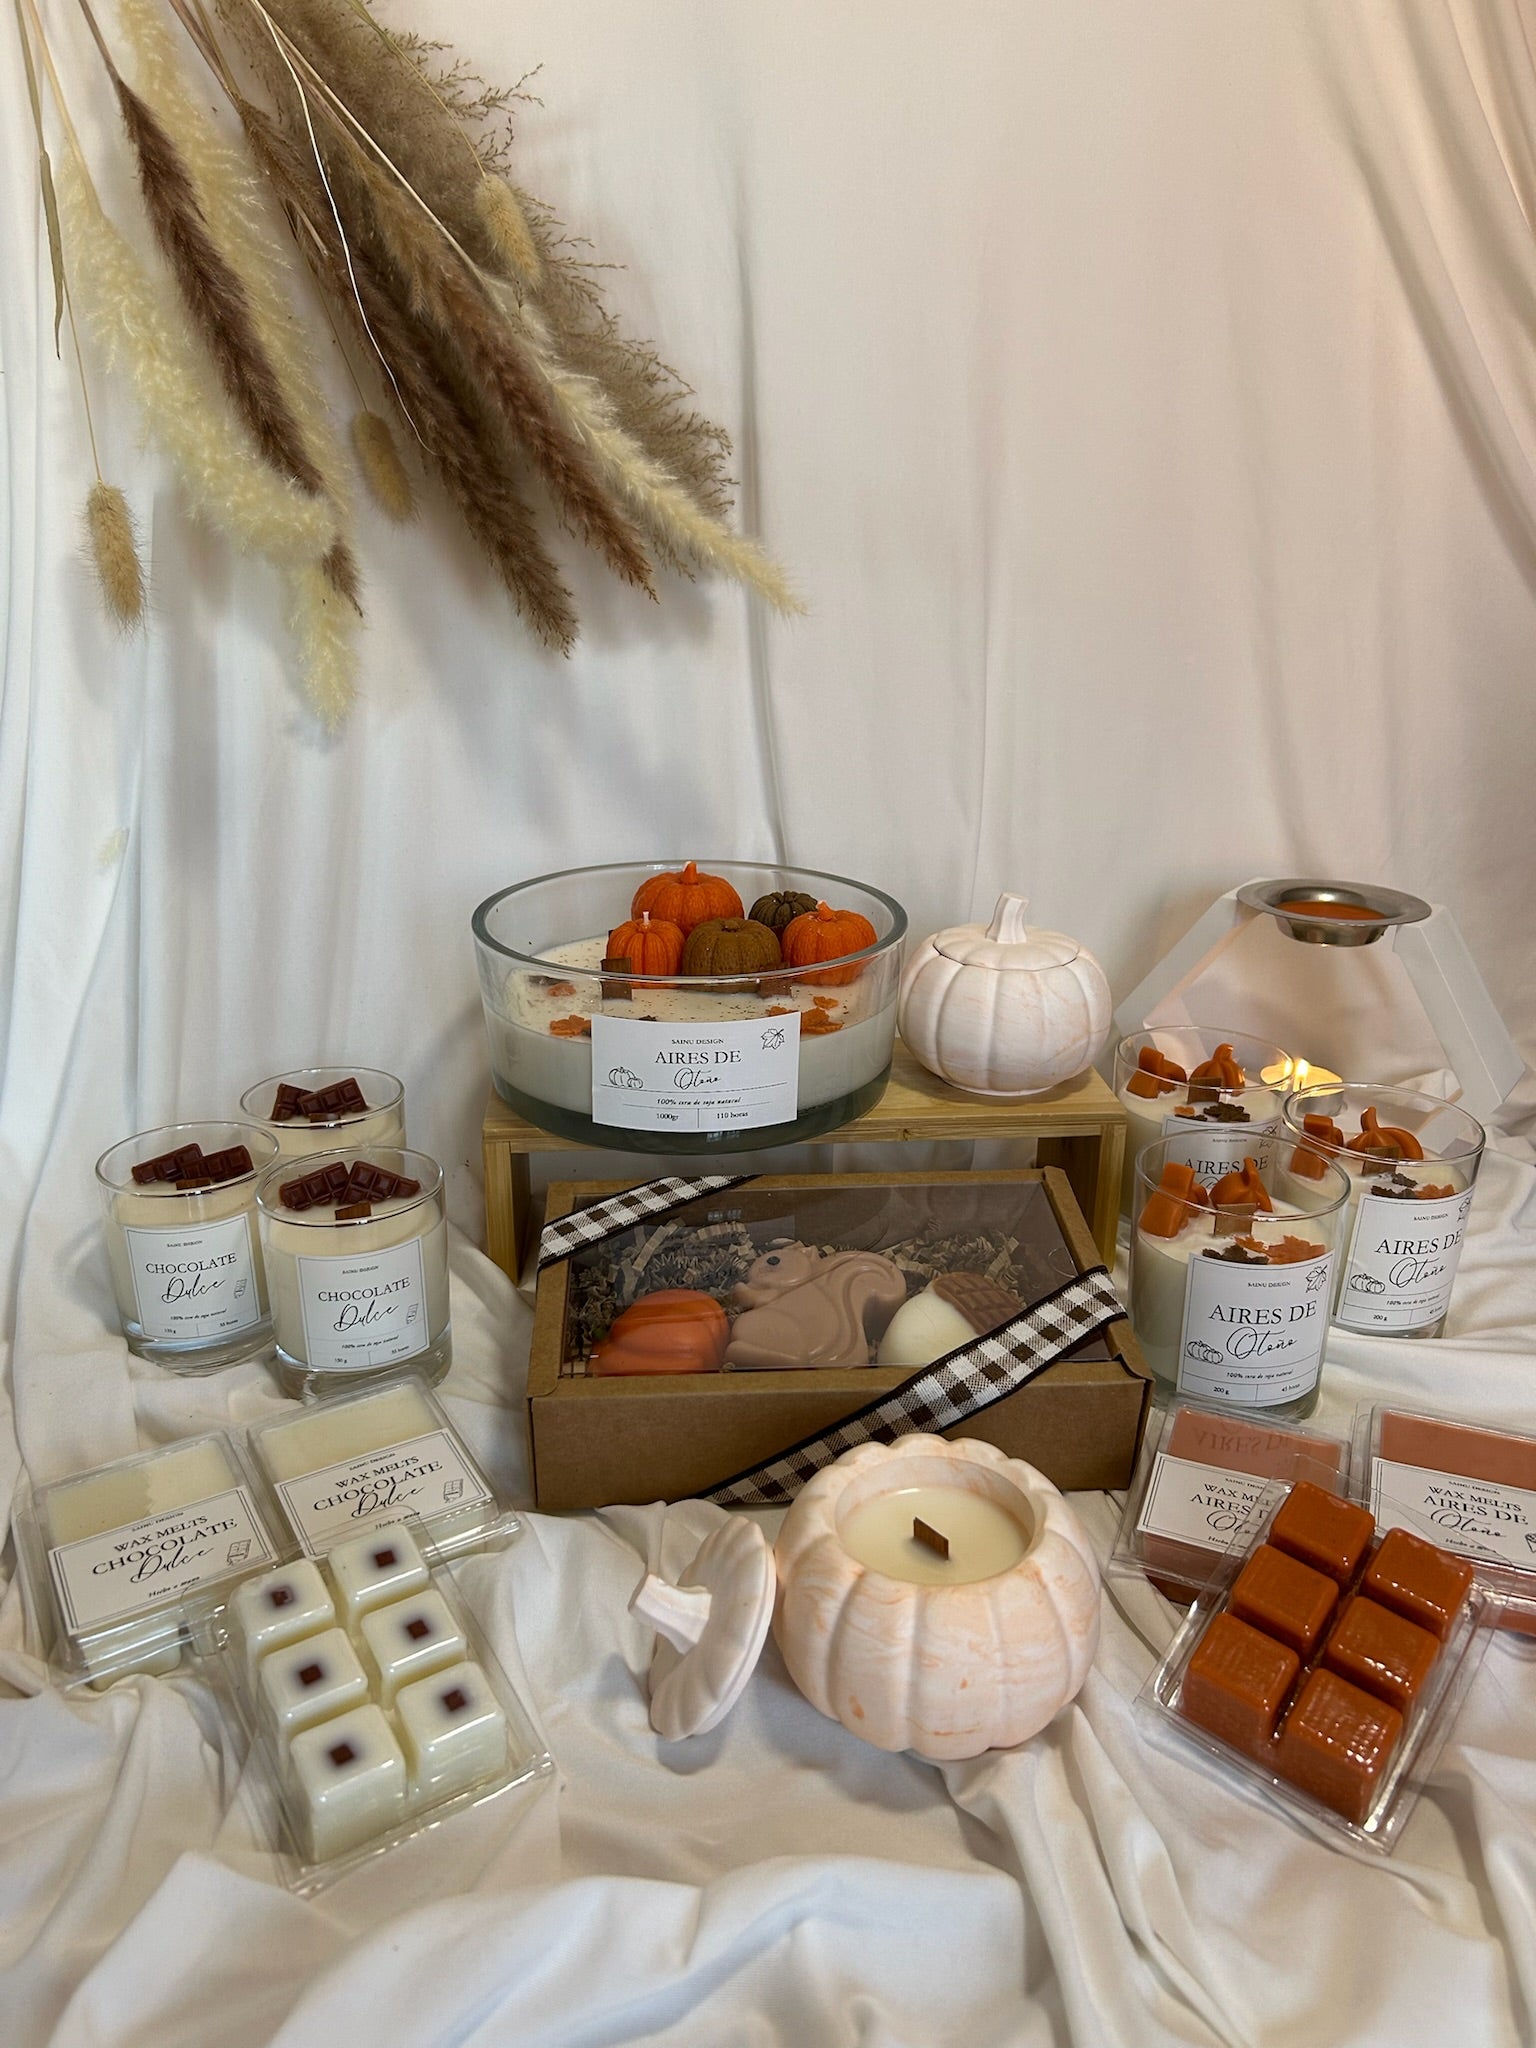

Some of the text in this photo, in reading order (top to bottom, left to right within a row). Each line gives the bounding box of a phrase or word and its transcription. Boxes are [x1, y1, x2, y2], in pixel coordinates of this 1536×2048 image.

[655, 1050, 742, 1064] AIRES DE
[1375, 1228, 1463, 1255] AIRES DE
[145, 1252, 238, 1274] CHOCOLATE
[161, 1273, 226, 1304] Dulce
[318, 1277, 411, 1302] CHOCOLATE
[333, 1299, 399, 1332] Dulce
[1208, 1300, 1317, 1325] AIRES DE
[1226, 1326, 1297, 1360] Otoño
[313, 1460, 443, 1512] CHOCOLATE
[335, 1456, 419, 1489] WAX MELTS
[351, 1485, 425, 1519] Dulce
[1190, 1493, 1252, 1515] AIRES
[1204, 1483, 1237, 1498] WAX
[1428, 1485, 1522, 1512] WAX MELTS
[1424, 1495, 1529, 1525] AIRES DE
[92, 1518, 238, 1576] CHOCOLATE
[114, 1515, 208, 1553] WAX MELTS
[130, 1545, 214, 1584] Dulce
